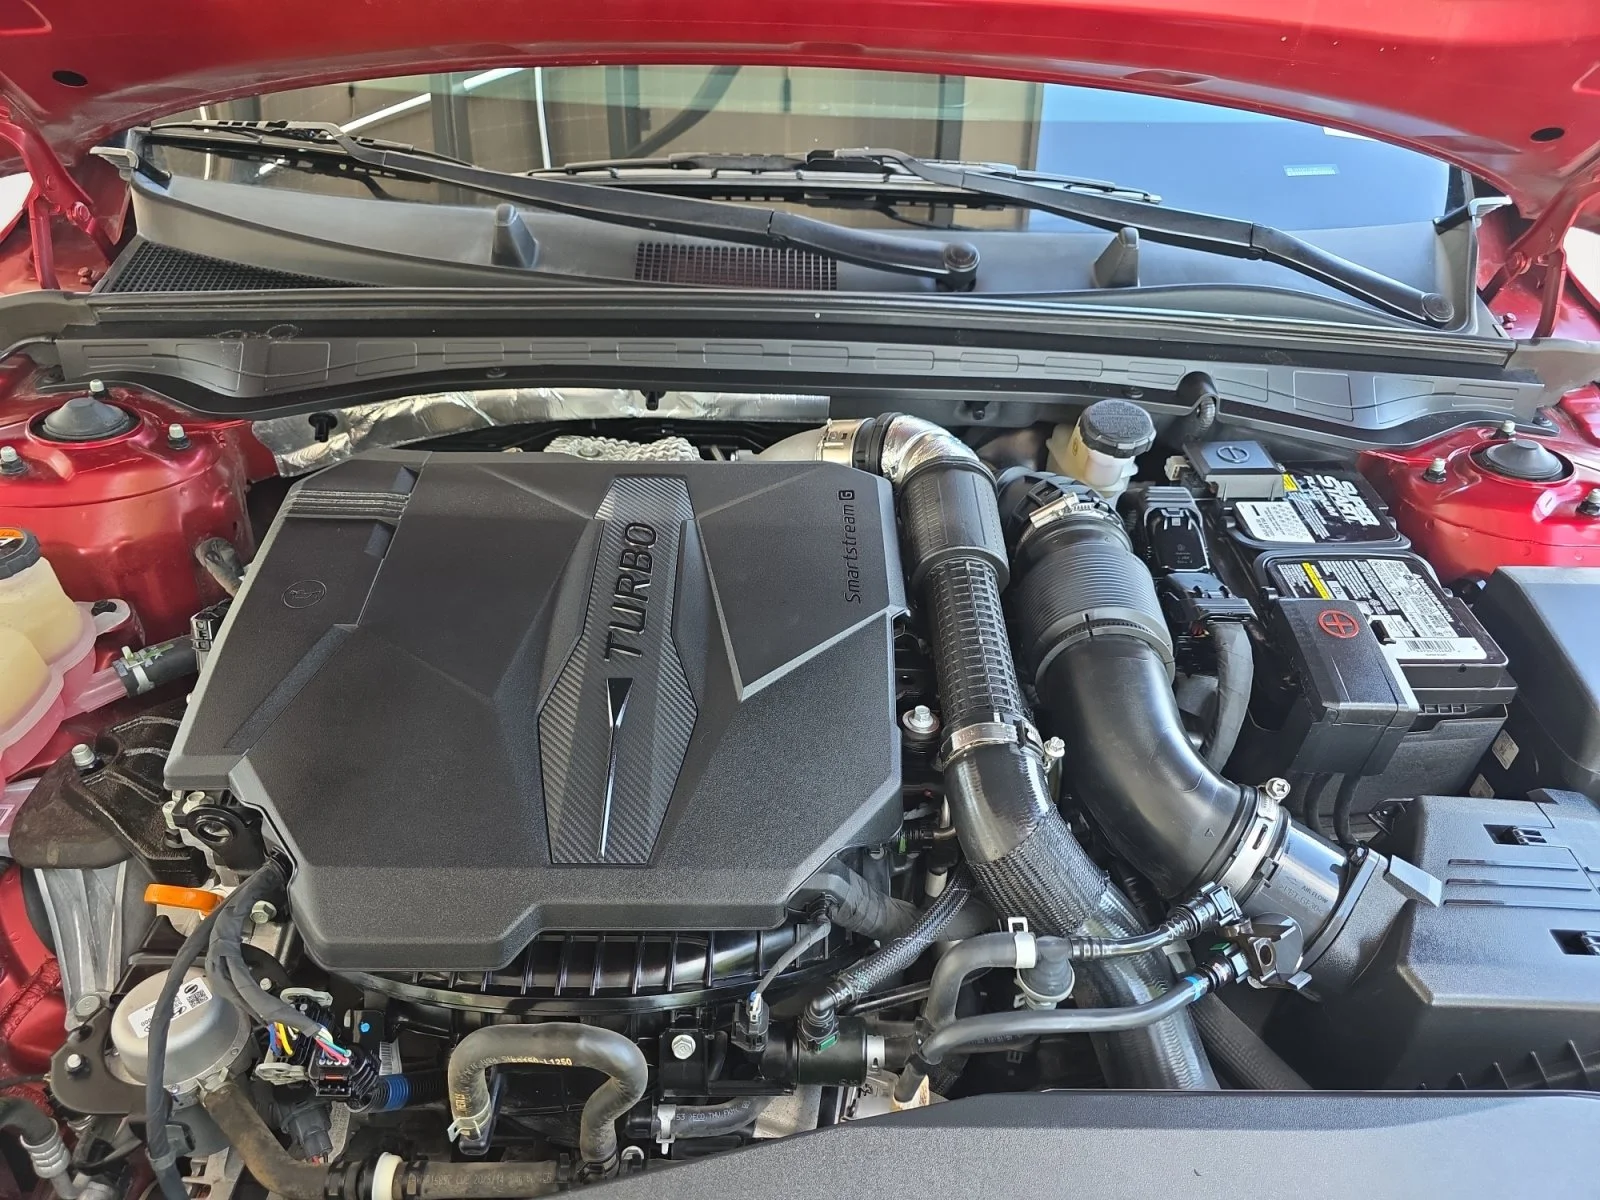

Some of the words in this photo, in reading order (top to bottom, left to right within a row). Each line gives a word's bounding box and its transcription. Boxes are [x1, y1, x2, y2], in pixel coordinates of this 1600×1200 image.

[1303, 475, 1339, 517] PLATINUM
[1316, 475, 1356, 524] START
[1340, 481, 1380, 526] SUPER
[842, 504, 861, 604] Smartstream
[604, 521, 657, 661] TURBO
